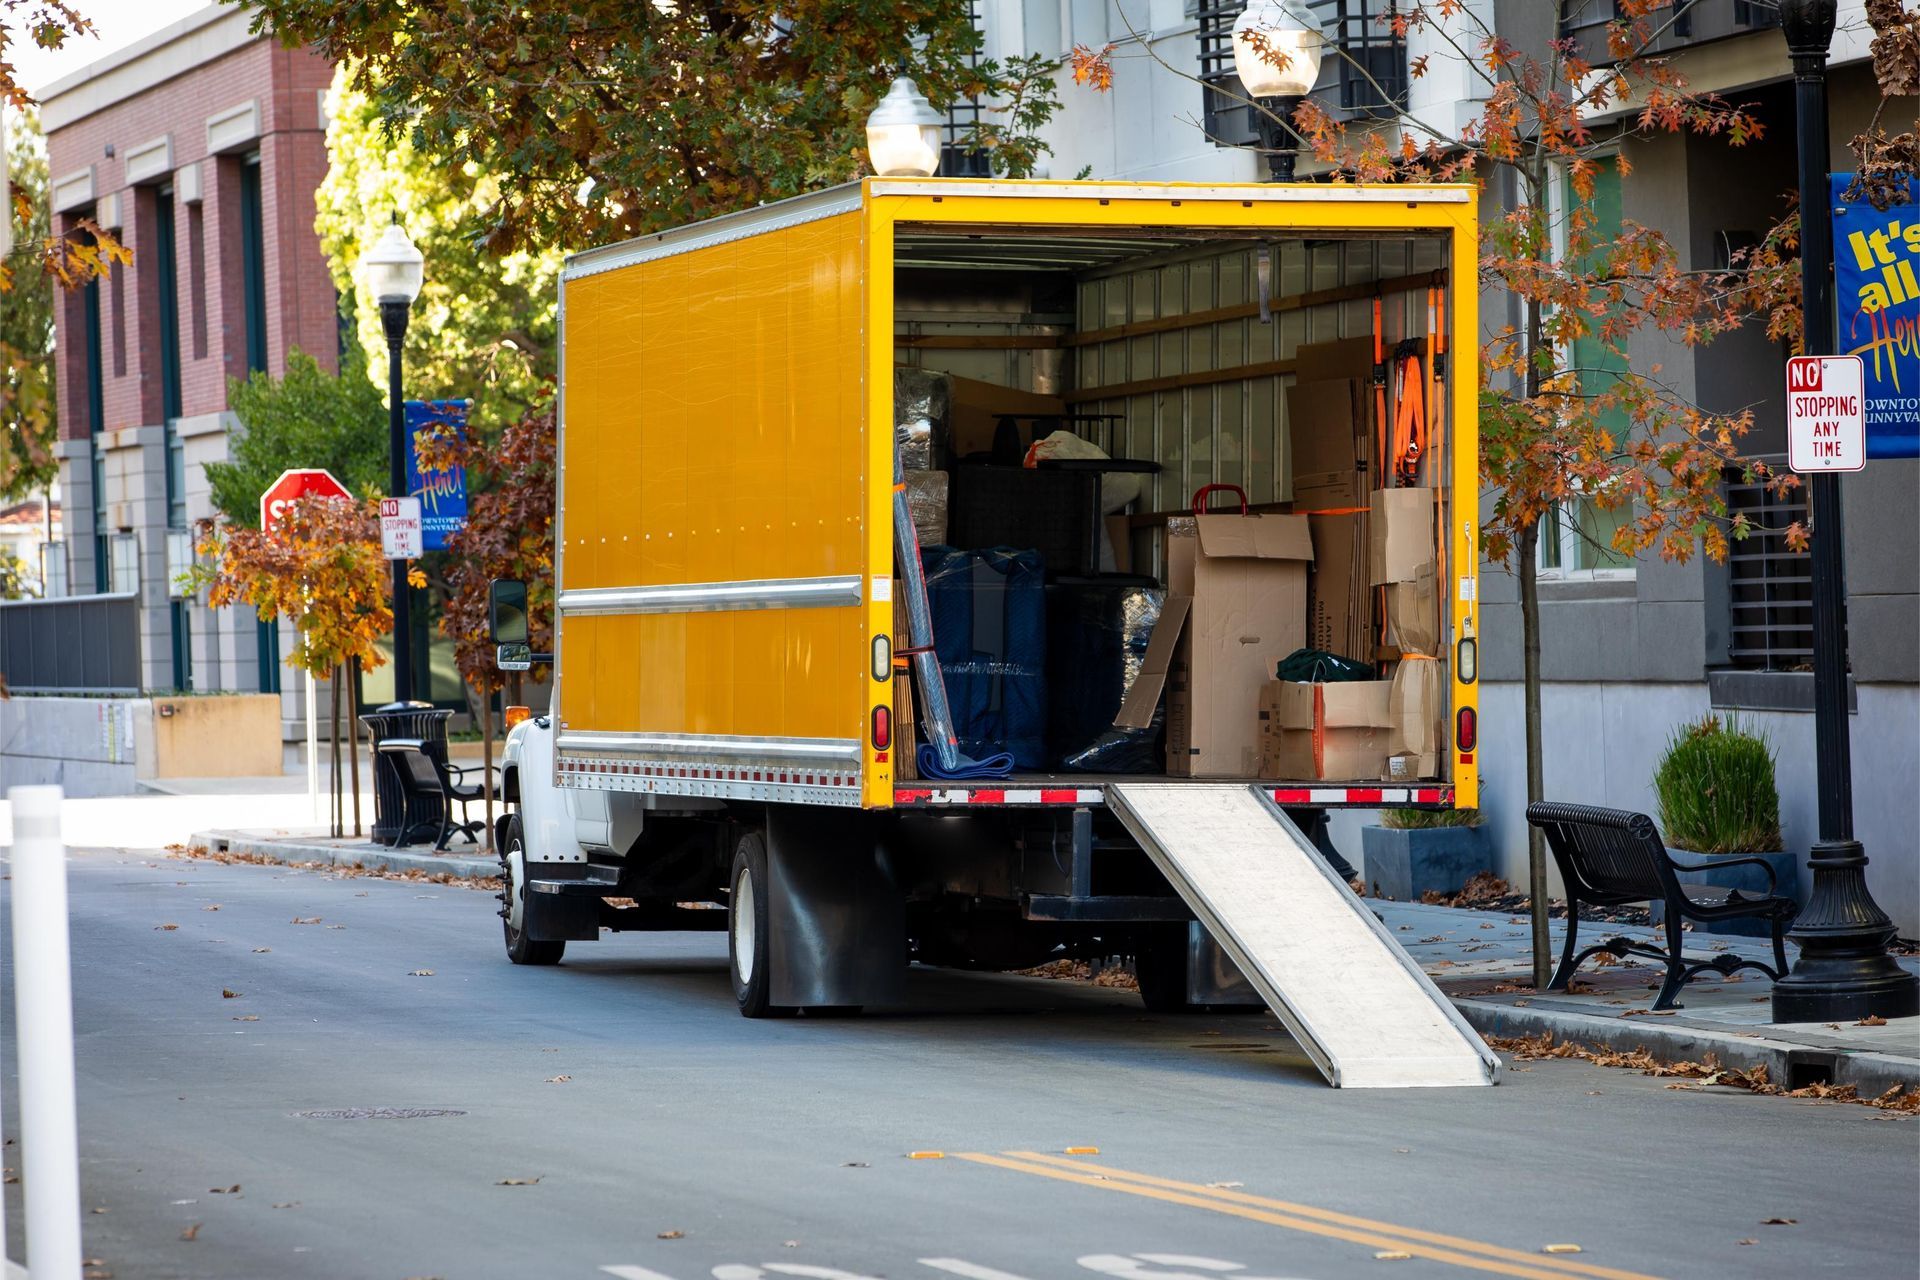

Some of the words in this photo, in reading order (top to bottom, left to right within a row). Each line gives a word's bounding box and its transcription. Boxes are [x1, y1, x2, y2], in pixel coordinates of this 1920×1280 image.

[1848, 219, 1920, 272] It's
[1858, 259, 1920, 314] all
[1846, 304, 1920, 394] Her
[1792, 362, 1820, 388] NO
[1795, 396, 1857, 418] STOPPING
[1864, 397, 1920, 411] OWNTO
[1864, 411, 1920, 424] UNNYVA
[1813, 421, 1840, 437] ANY
[1812, 441, 1842, 457] TIME
[382, 501, 397, 516] NO
[384, 518, 418, 530] STOPPING
[395, 532, 409, 541] ANY
[394, 541, 410, 551] TIME
